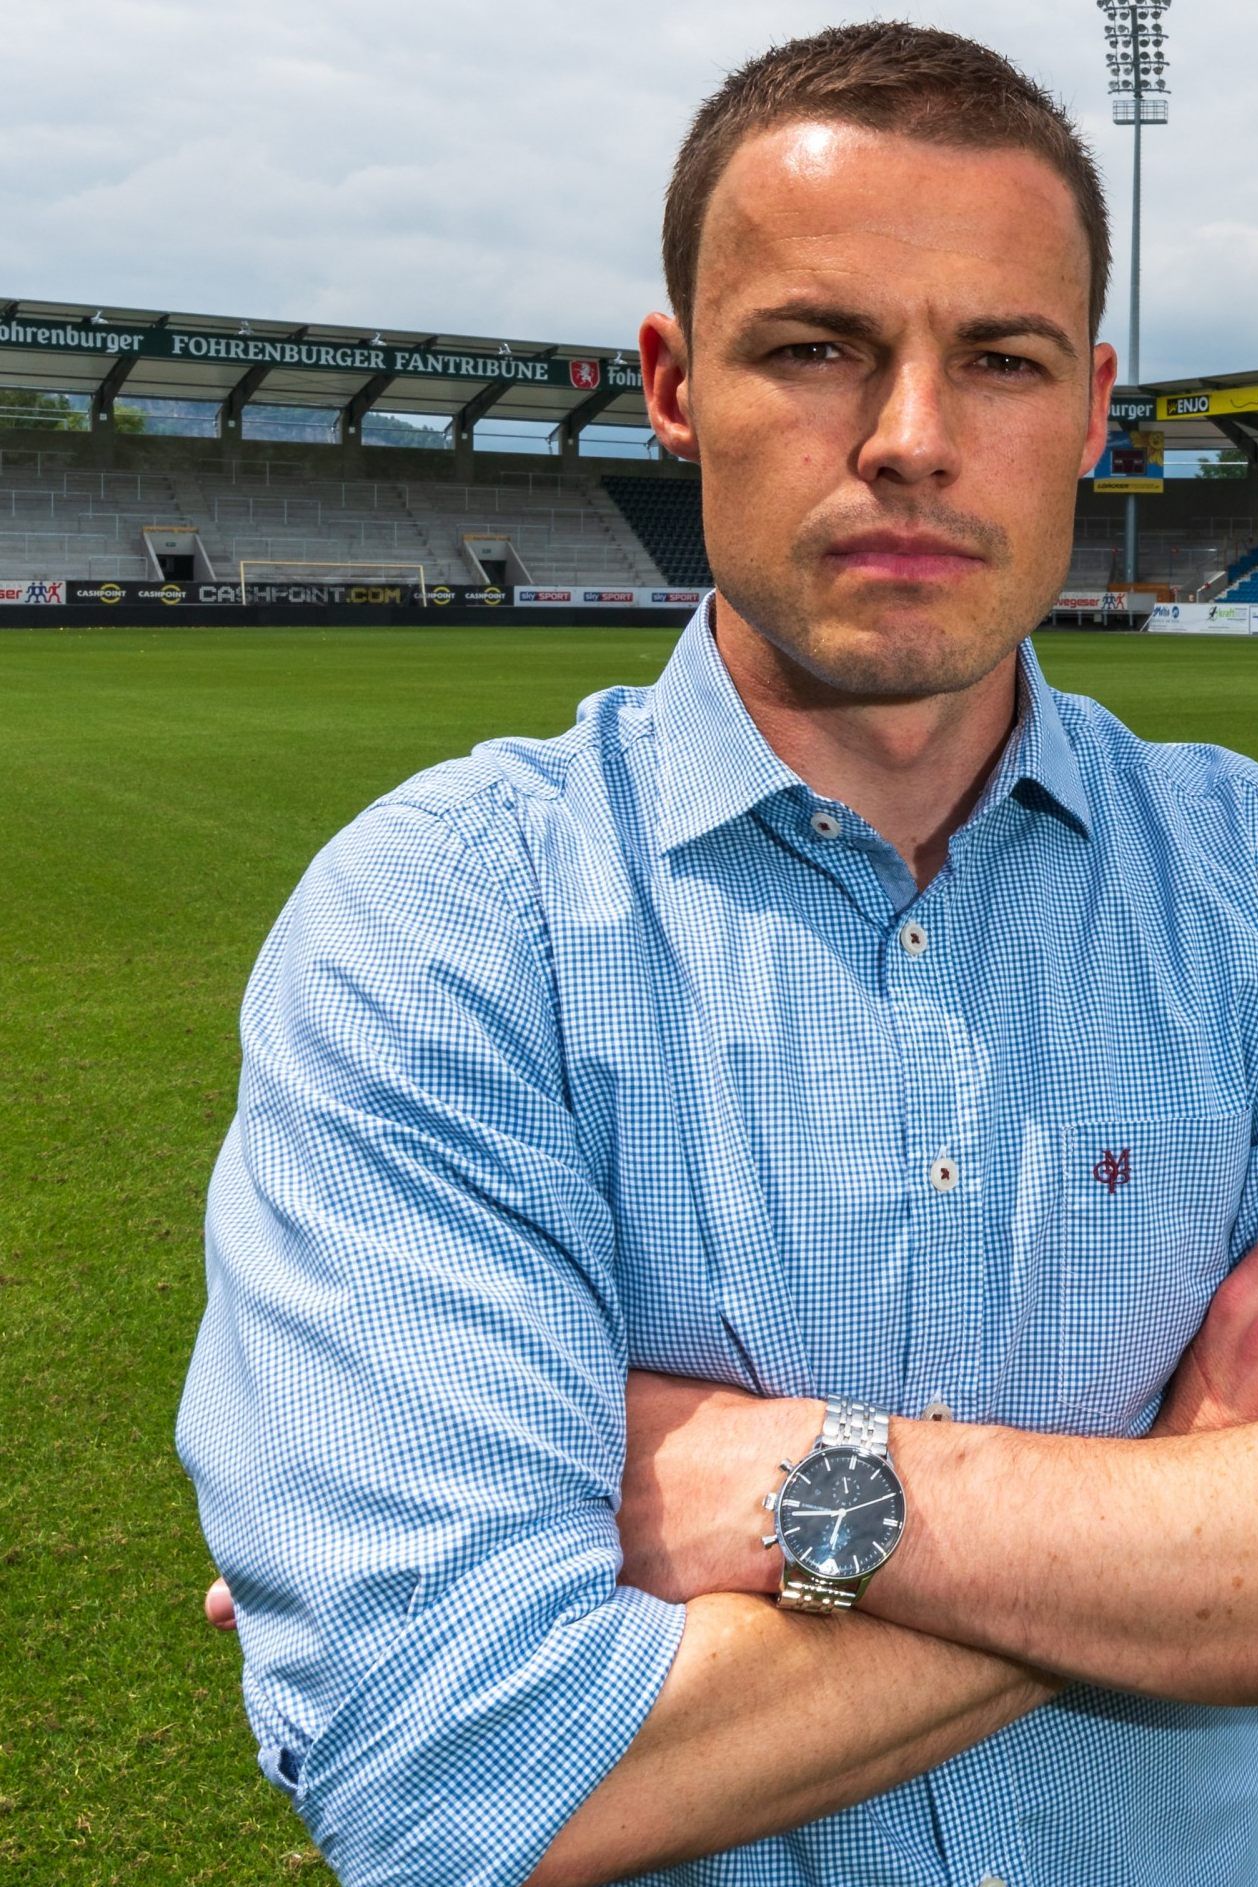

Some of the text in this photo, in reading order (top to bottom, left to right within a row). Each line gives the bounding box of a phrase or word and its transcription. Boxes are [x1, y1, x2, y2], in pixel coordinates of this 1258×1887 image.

[0, 319, 144, 353] ohrenburger
[172, 335, 549, 381] FOHRENBURGER FANTRIBÜNE
[1177, 397, 1209, 414] ENJO
[1108, 404, 1154, 420] urger
[76, 590, 127, 598] CASHPOINT
[138, 590, 187, 598] CASHPOINT
[464, 592, 506, 600] CASHPOINT
[521, 592, 570, 601] sky SPORT
[585, 592, 633, 601] sky SPORT
[653, 592, 699, 602] sky SPORT
